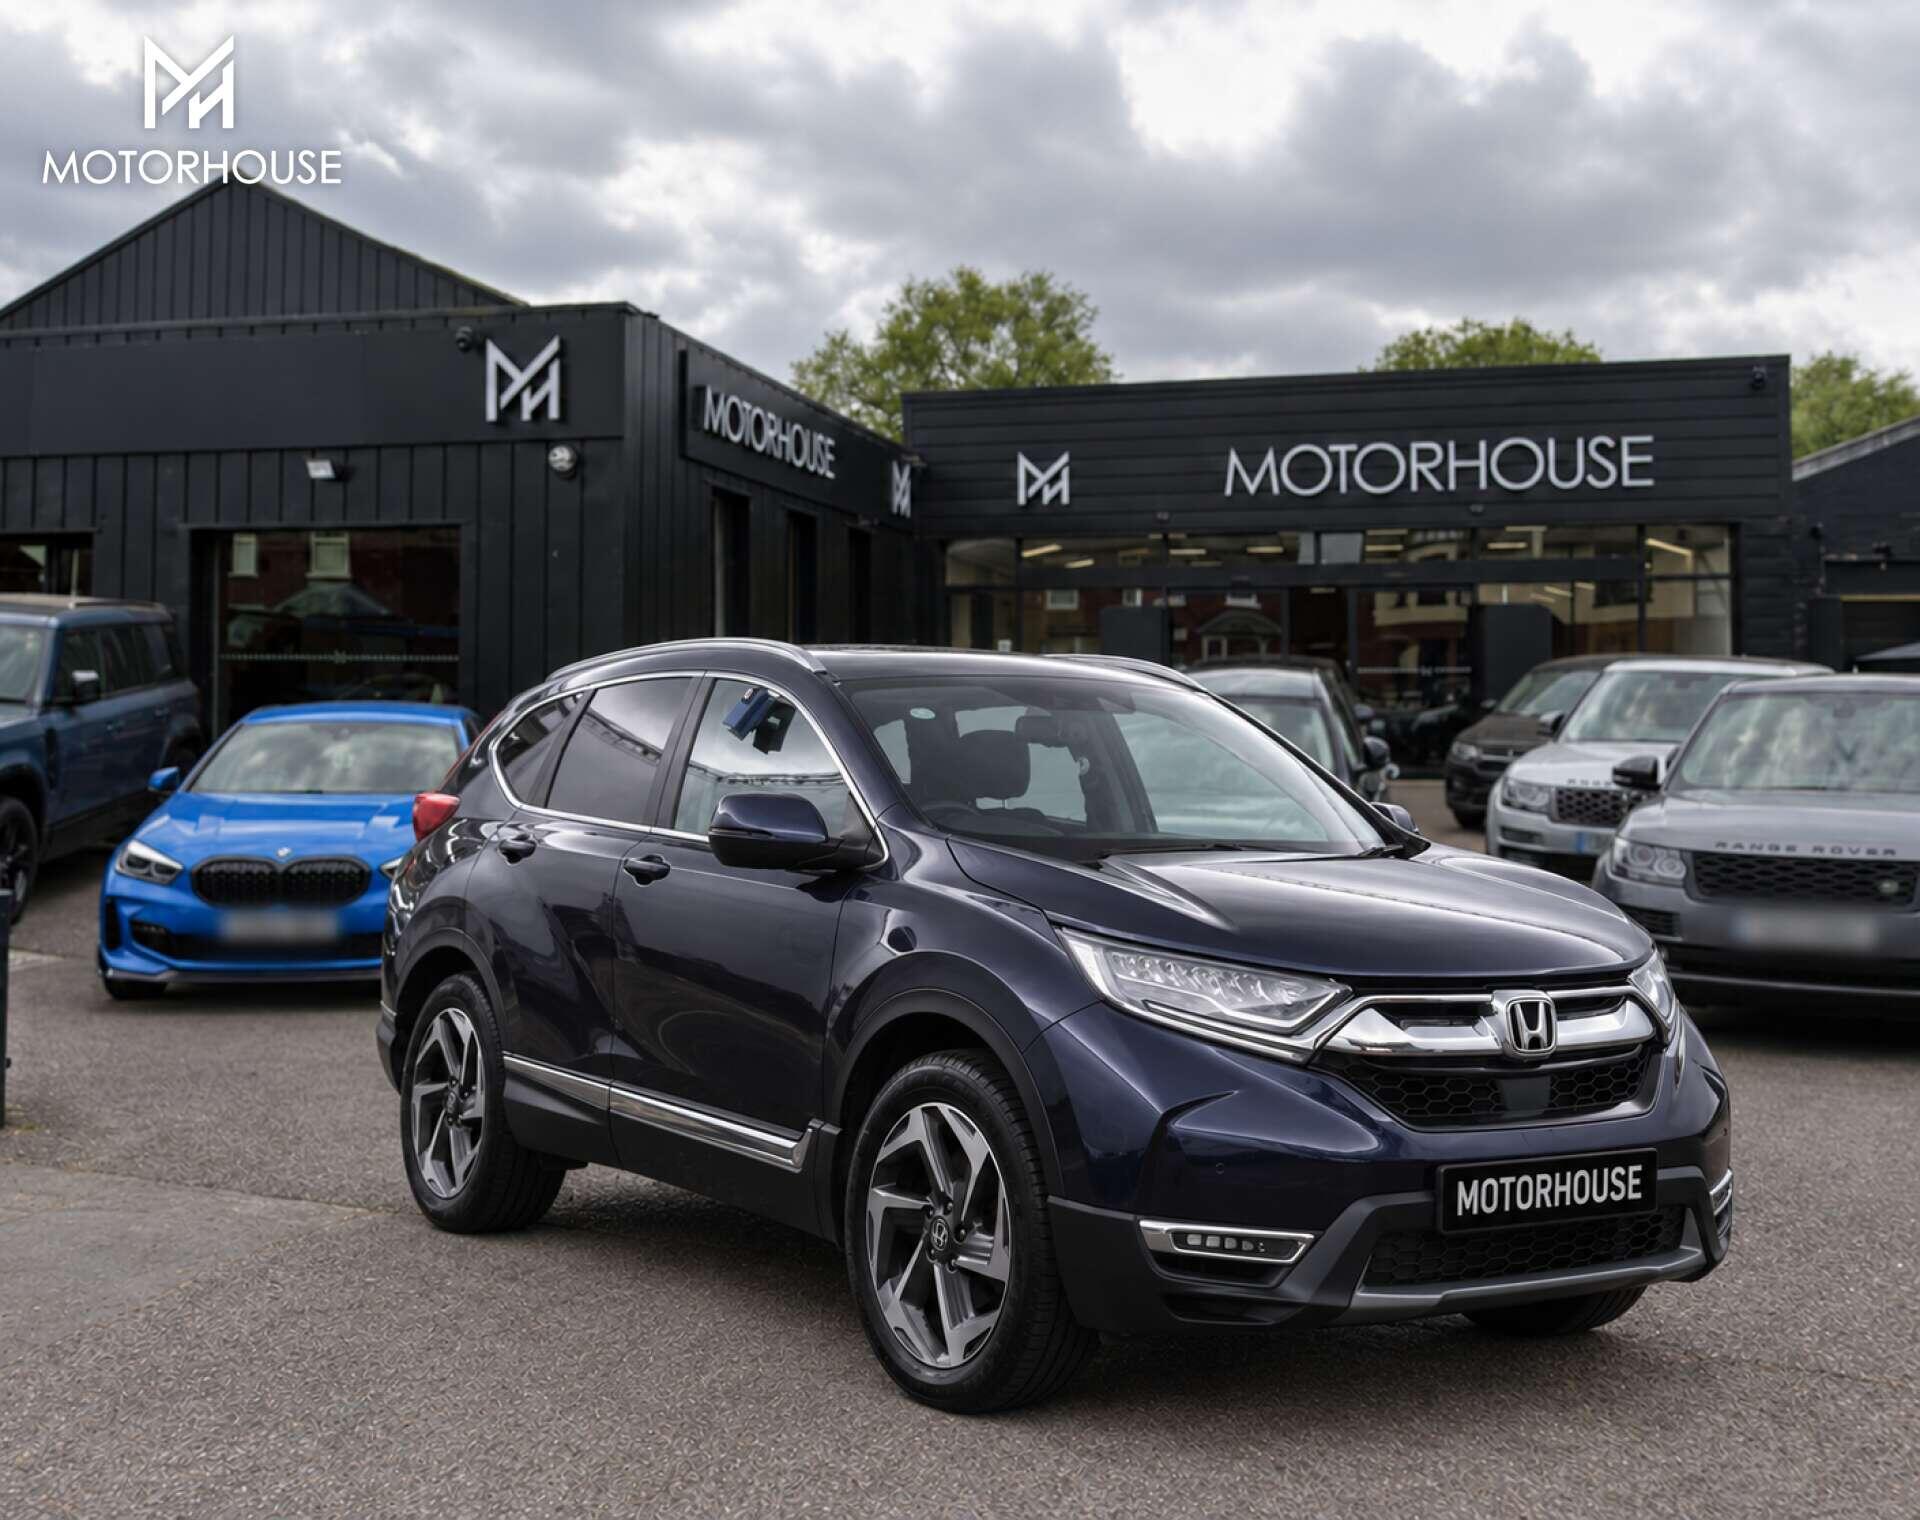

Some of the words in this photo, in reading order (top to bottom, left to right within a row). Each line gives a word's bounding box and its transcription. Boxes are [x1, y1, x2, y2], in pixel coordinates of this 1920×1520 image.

[703, 385, 836, 480] MOTORHOUSE
[1225, 435, 1655, 497] MOTORHOUSE
[1715, 842, 1798, 853] RANGE
[1811, 845, 1897, 857] ROVER
[1456, 1164, 1643, 1217] MOTORHOUSE
